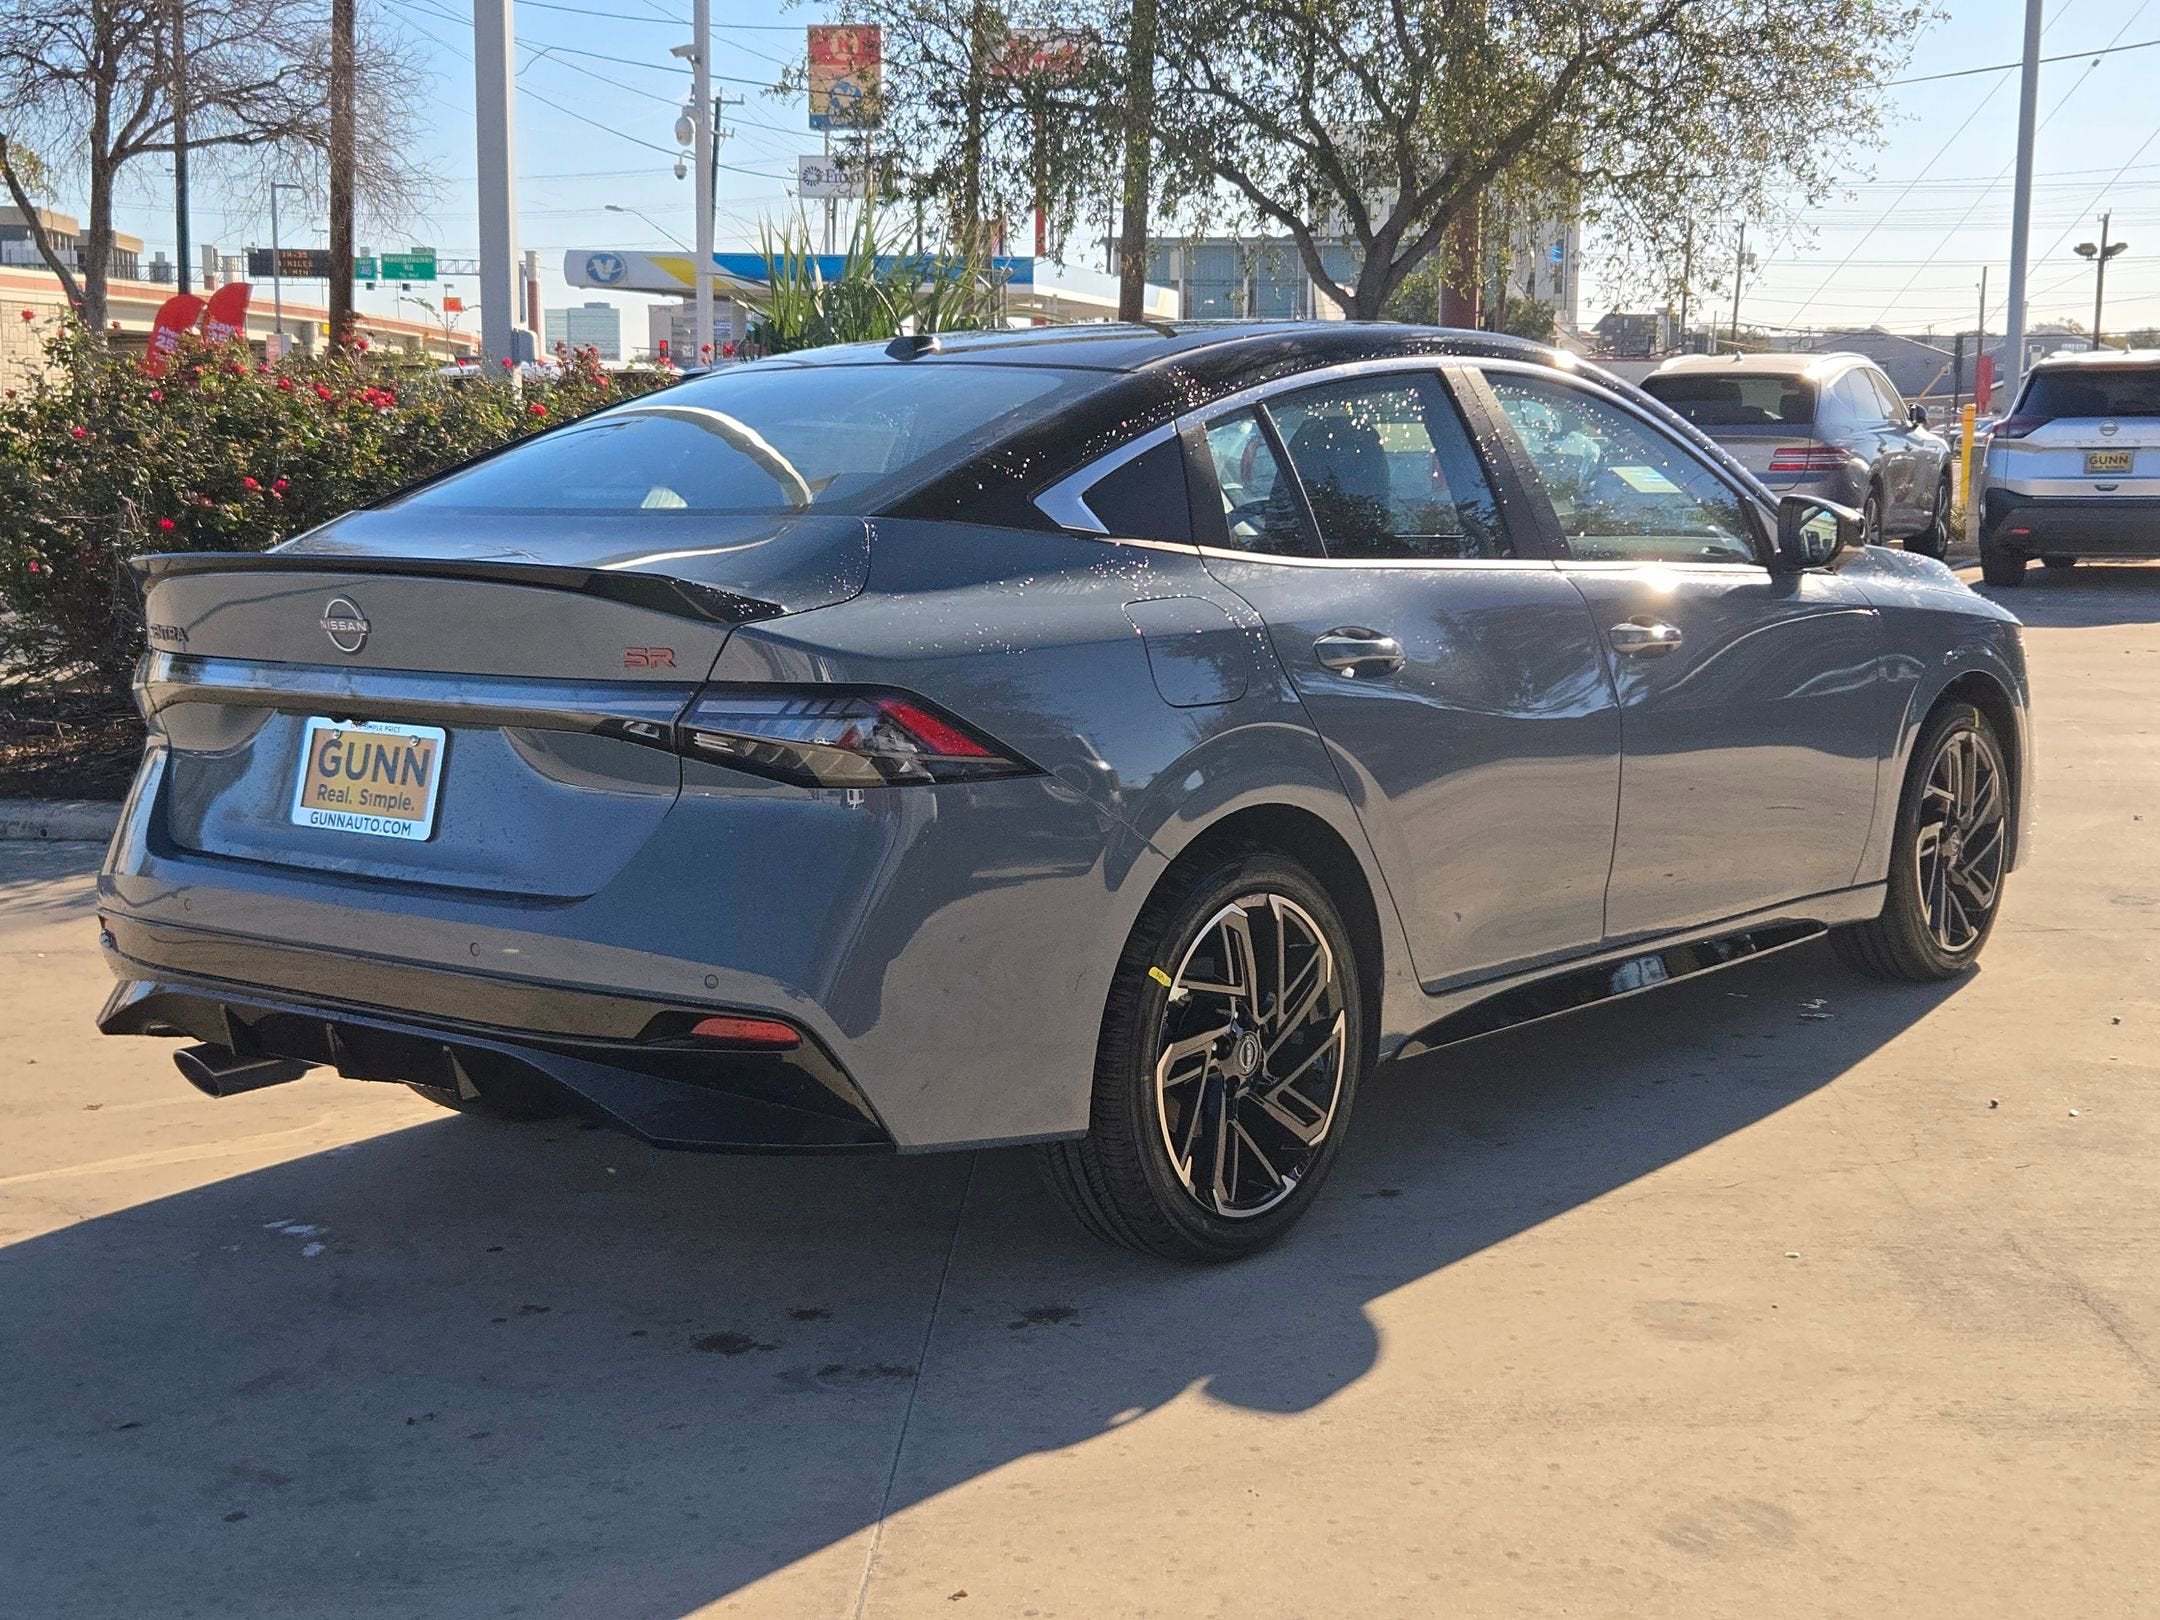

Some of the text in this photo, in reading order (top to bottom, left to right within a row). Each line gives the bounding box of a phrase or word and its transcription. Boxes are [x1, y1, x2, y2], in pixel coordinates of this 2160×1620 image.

[2089, 455, 2129, 465] GUNN
[320, 620, 367, 632] NISSAN
[623, 646, 677, 668] SR
[318, 739, 431, 787] GUNN
[316, 783, 415, 812] Real. Simple.
[310, 811, 412, 836] GUNNAUTO.COM
